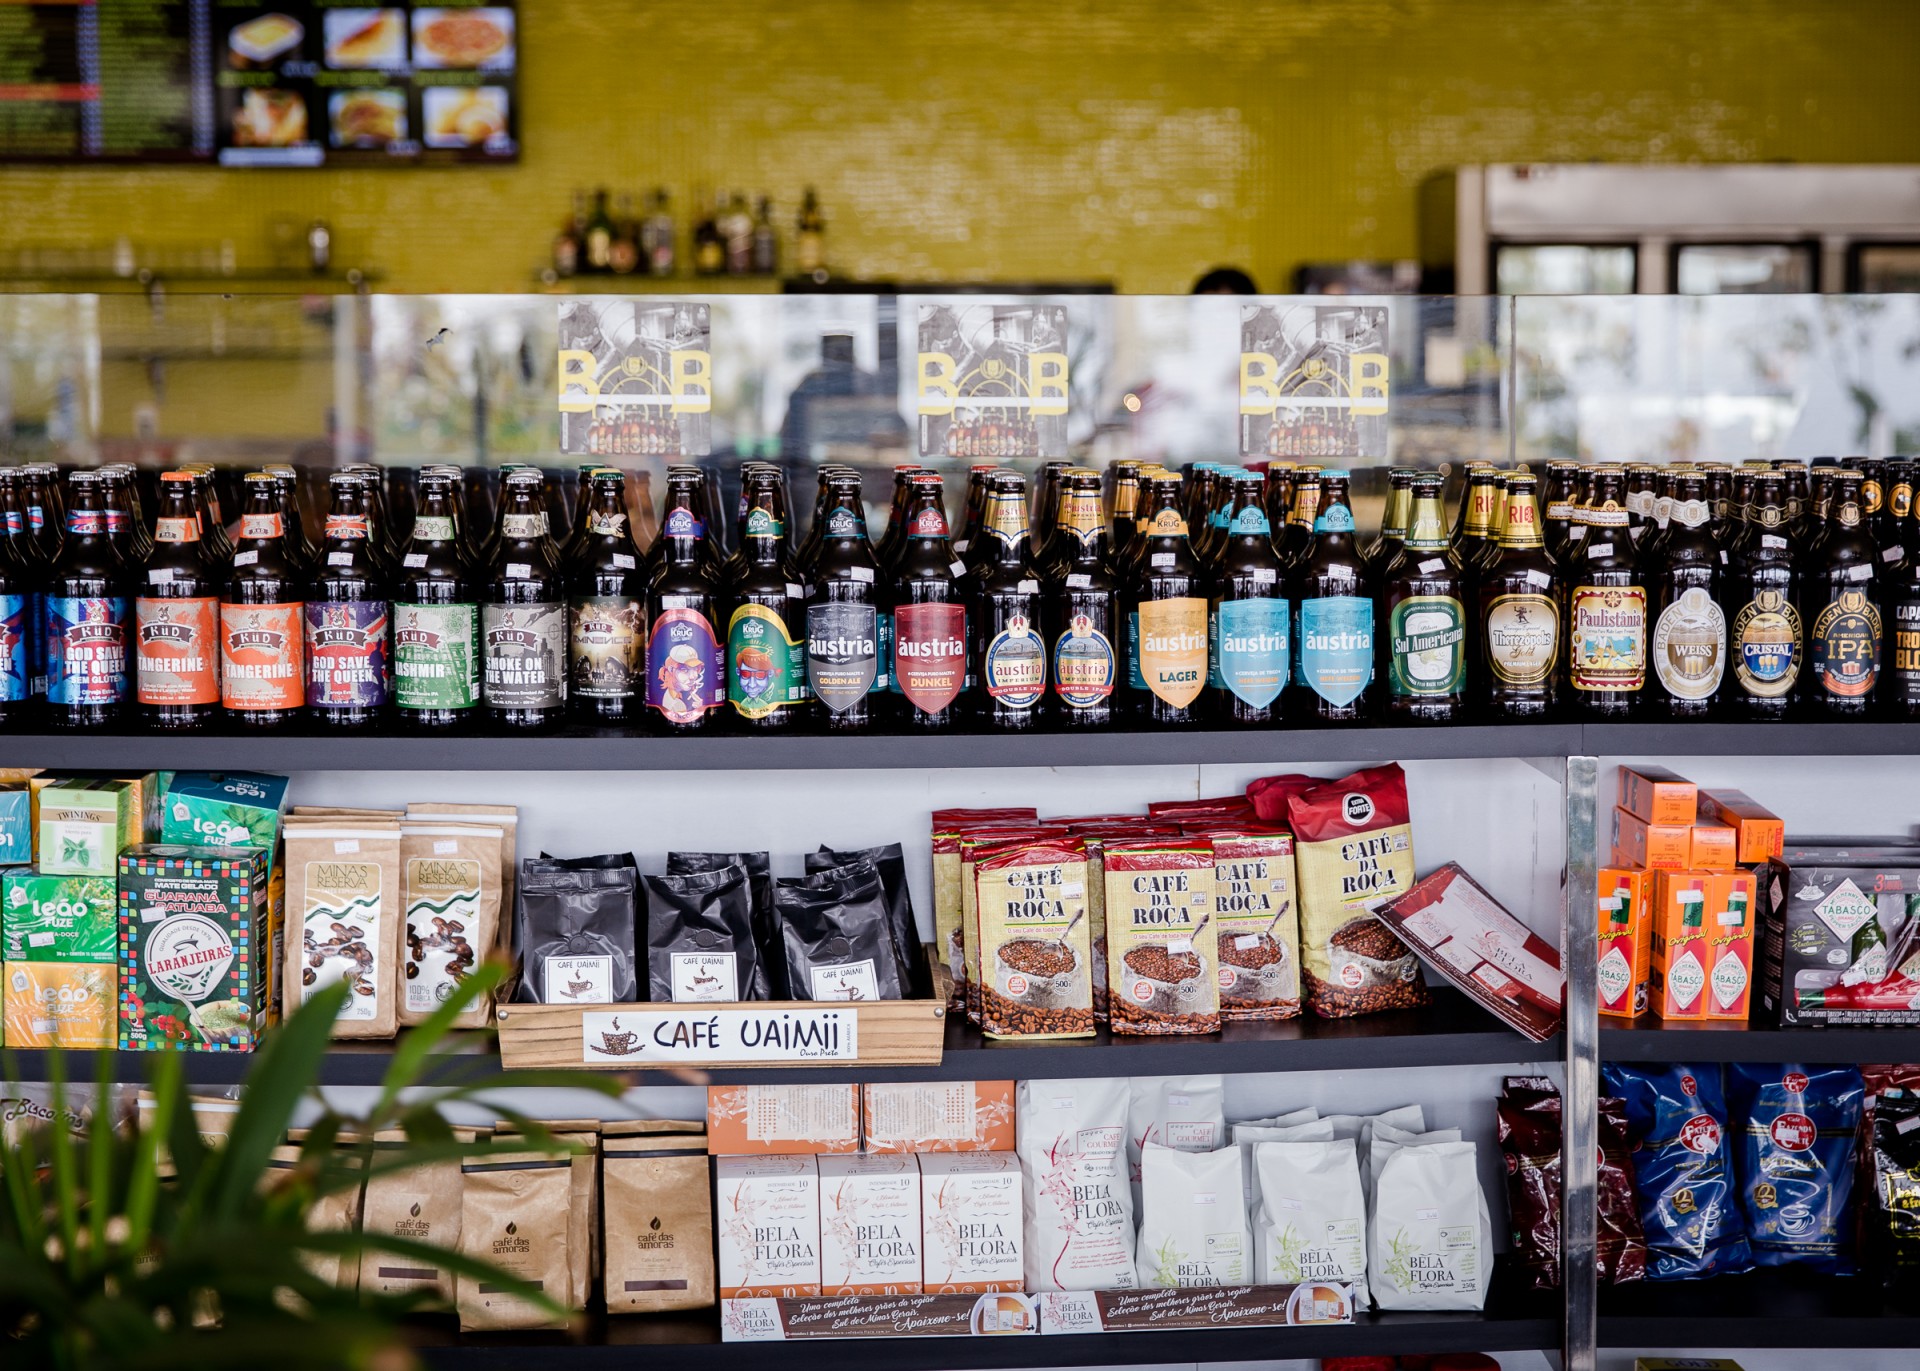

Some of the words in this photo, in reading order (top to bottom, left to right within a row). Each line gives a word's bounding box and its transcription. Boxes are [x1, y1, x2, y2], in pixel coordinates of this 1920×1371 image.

[919, 519, 943, 531] KRUG
[1156, 519, 1180, 530] KRUG
[1240, 516, 1262, 527] KRUG
[1325, 515, 1348, 526] KRUG
[1579, 608, 1642, 629] Paulistânia
[1816, 607, 1843, 640] BADEN
[1863, 606, 1881, 640] BADEN
[1657, 607, 1685, 651] BADEN
[1707, 608, 1725, 652] BADEN
[1733, 605, 1757, 650] BADEN
[1782, 606, 1802, 650] BADEN
[809, 634, 875, 656] áustria
[1145, 630, 1206, 653] áustria
[1223, 631, 1287, 653] áustria
[1306, 630, 1370, 652] áustria
[1395, 637, 1410, 654] Sul
[1411, 628, 1463, 652] Americana
[1493, 630, 1551, 648] Therezópolis
[66, 646, 94, 661] GOD
[96, 646, 123, 660] SAVE
[898, 636, 964, 658] áustria
[1509, 645, 1536, 659] Gold
[1676, 644, 1713, 658] WEISS
[1744, 643, 1792, 657] CRISTAL
[1828, 639, 1872, 660] IPA
[64, 660, 88, 674] THE
[91, 660, 126, 676] QUEEN
[138, 657, 204, 673] TANGERINE
[313, 656, 336, 670] GOD
[338, 655, 371, 670] SAVE
[486, 657, 521, 671] SMOKE
[525, 658, 542, 671] ON
[995, 662, 1041, 677] áustria
[1060, 662, 1106, 676] áustria
[225, 663, 294, 680] TANGERINE
[312, 670, 331, 684] THE
[334, 670, 374, 685] QUEEN
[485, 669, 501, 684] THE
[503, 670, 546, 685] WATER
[1159, 670, 1198, 683] LAGER
[820, 677, 848, 686] GOLDEN
[849, 677, 861, 685] ALE
[910, 677, 953, 688] DUNKEL
[57, 811, 102, 822] TWININGS
[1348, 804, 1371, 816] FORTE
[1342, 832, 1392, 861] CAFÉ
[318, 864, 368, 878] MINAS
[419, 861, 467, 876] MINAS
[1215, 859, 1268, 881] CAFÉ
[1359, 858, 1378, 873] DA
[317, 876, 368, 889] RESERVA
[418, 873, 469, 885] RESERVA
[1007, 866, 1062, 887] CAFÉ
[1133, 872, 1188, 893] CAFÉ
[1342, 869, 1397, 894] ROÇA
[1873, 874, 1885, 891] 3
[155, 882, 182, 890] MATE
[1231, 882, 1252, 894] DA
[144, 890, 222, 903] GUARANÁ
[1025, 888, 1046, 900] DA
[1152, 894, 1171, 906] DA
[32, 899, 89, 917] leão
[1007, 901, 1066, 921] ROÇA
[1216, 894, 1271, 915] ROÇA
[1822, 905, 1871, 916] TABASCO
[45, 918, 75, 929] FUZE
[1133, 907, 1190, 927] ROÇA
[1598, 927, 1635, 943] Original
[1669, 928, 1708, 947] Original
[1711, 928, 1751, 947] Original
[148, 944, 234, 975] LARANJEIRAS
[558, 960, 573, 968] CAFÉ
[683, 957, 699, 966] CAFÉ
[823, 970, 838, 979] CAFÉ
[1671, 971, 1703, 985] TABASCO
[1714, 971, 1746, 985] TABASCO
[34, 984, 89, 1003] leão
[47, 1003, 76, 1014] FUZE
[130, 1032, 147, 1041] 500g
[653, 1015, 719, 1049] CAFÉ
[900, 1178, 910, 1188] 10
[1003, 1177, 1013, 1187] 10
[1074, 1183, 1111, 1203] BELA
[1075, 1200, 1123, 1219] FLORA
[639, 1231, 658, 1243] café
[659, 1232, 674, 1242] das
[755, 1226, 800, 1243] BELA
[857, 1225, 902, 1241] BELA
[960, 1224, 1003, 1240] BELA
[493, 1235, 514, 1248] café
[515, 1236, 530, 1247] das
[639, 1239, 674, 1250] amoras
[493, 1244, 530, 1255] amoras
[755, 1246, 815, 1262] FLORA
[857, 1244, 917, 1260] FLORA
[960, 1241, 1017, 1258] FLORA
[1300, 1251, 1334, 1264] BELA
[1410, 1256, 1444, 1269] BELA
[1178, 1264, 1212, 1276] BELA
[1300, 1264, 1345, 1278] FLORA
[1410, 1269, 1455, 1283] FLORA
[801, 1303, 824, 1313] Uma
[826, 1297, 860, 1310] completa
[1106, 1305, 1139, 1318] Seleção
[1141, 1303, 1155, 1312] dos
[1156, 1298, 1187, 1310] melhores
[1190, 1295, 1212, 1306] grãos
[1225, 1288, 1250, 1299] região
[1117, 1295, 1139, 1306] Uma
[1141, 1289, 1175, 1303] completa
[743, 1309, 768, 1319] BELA
[790, 1312, 823, 1325] Seleção
[825, 1310, 842, 1320] dos
[844, 1305, 873, 1317] melhores
[875, 1302, 898, 1313] grãos
[911, 1296, 935, 1306] região
[1062, 1303, 1086, 1313] BELA
[1149, 1311, 1166, 1321] Sul
[1177, 1305, 1206, 1317] Minas
[1210, 1299, 1286, 1323] Apaixone-se!
[744, 1318, 780, 1328] FLORA
[832, 1318, 850, 1330] Sul
[851, 1318, 862, 1326] de
[860, 1312, 892, 1325] Minas
[894, 1308, 971, 1333] Apaixone-se!
[1063, 1312, 1094, 1322] FLORA
